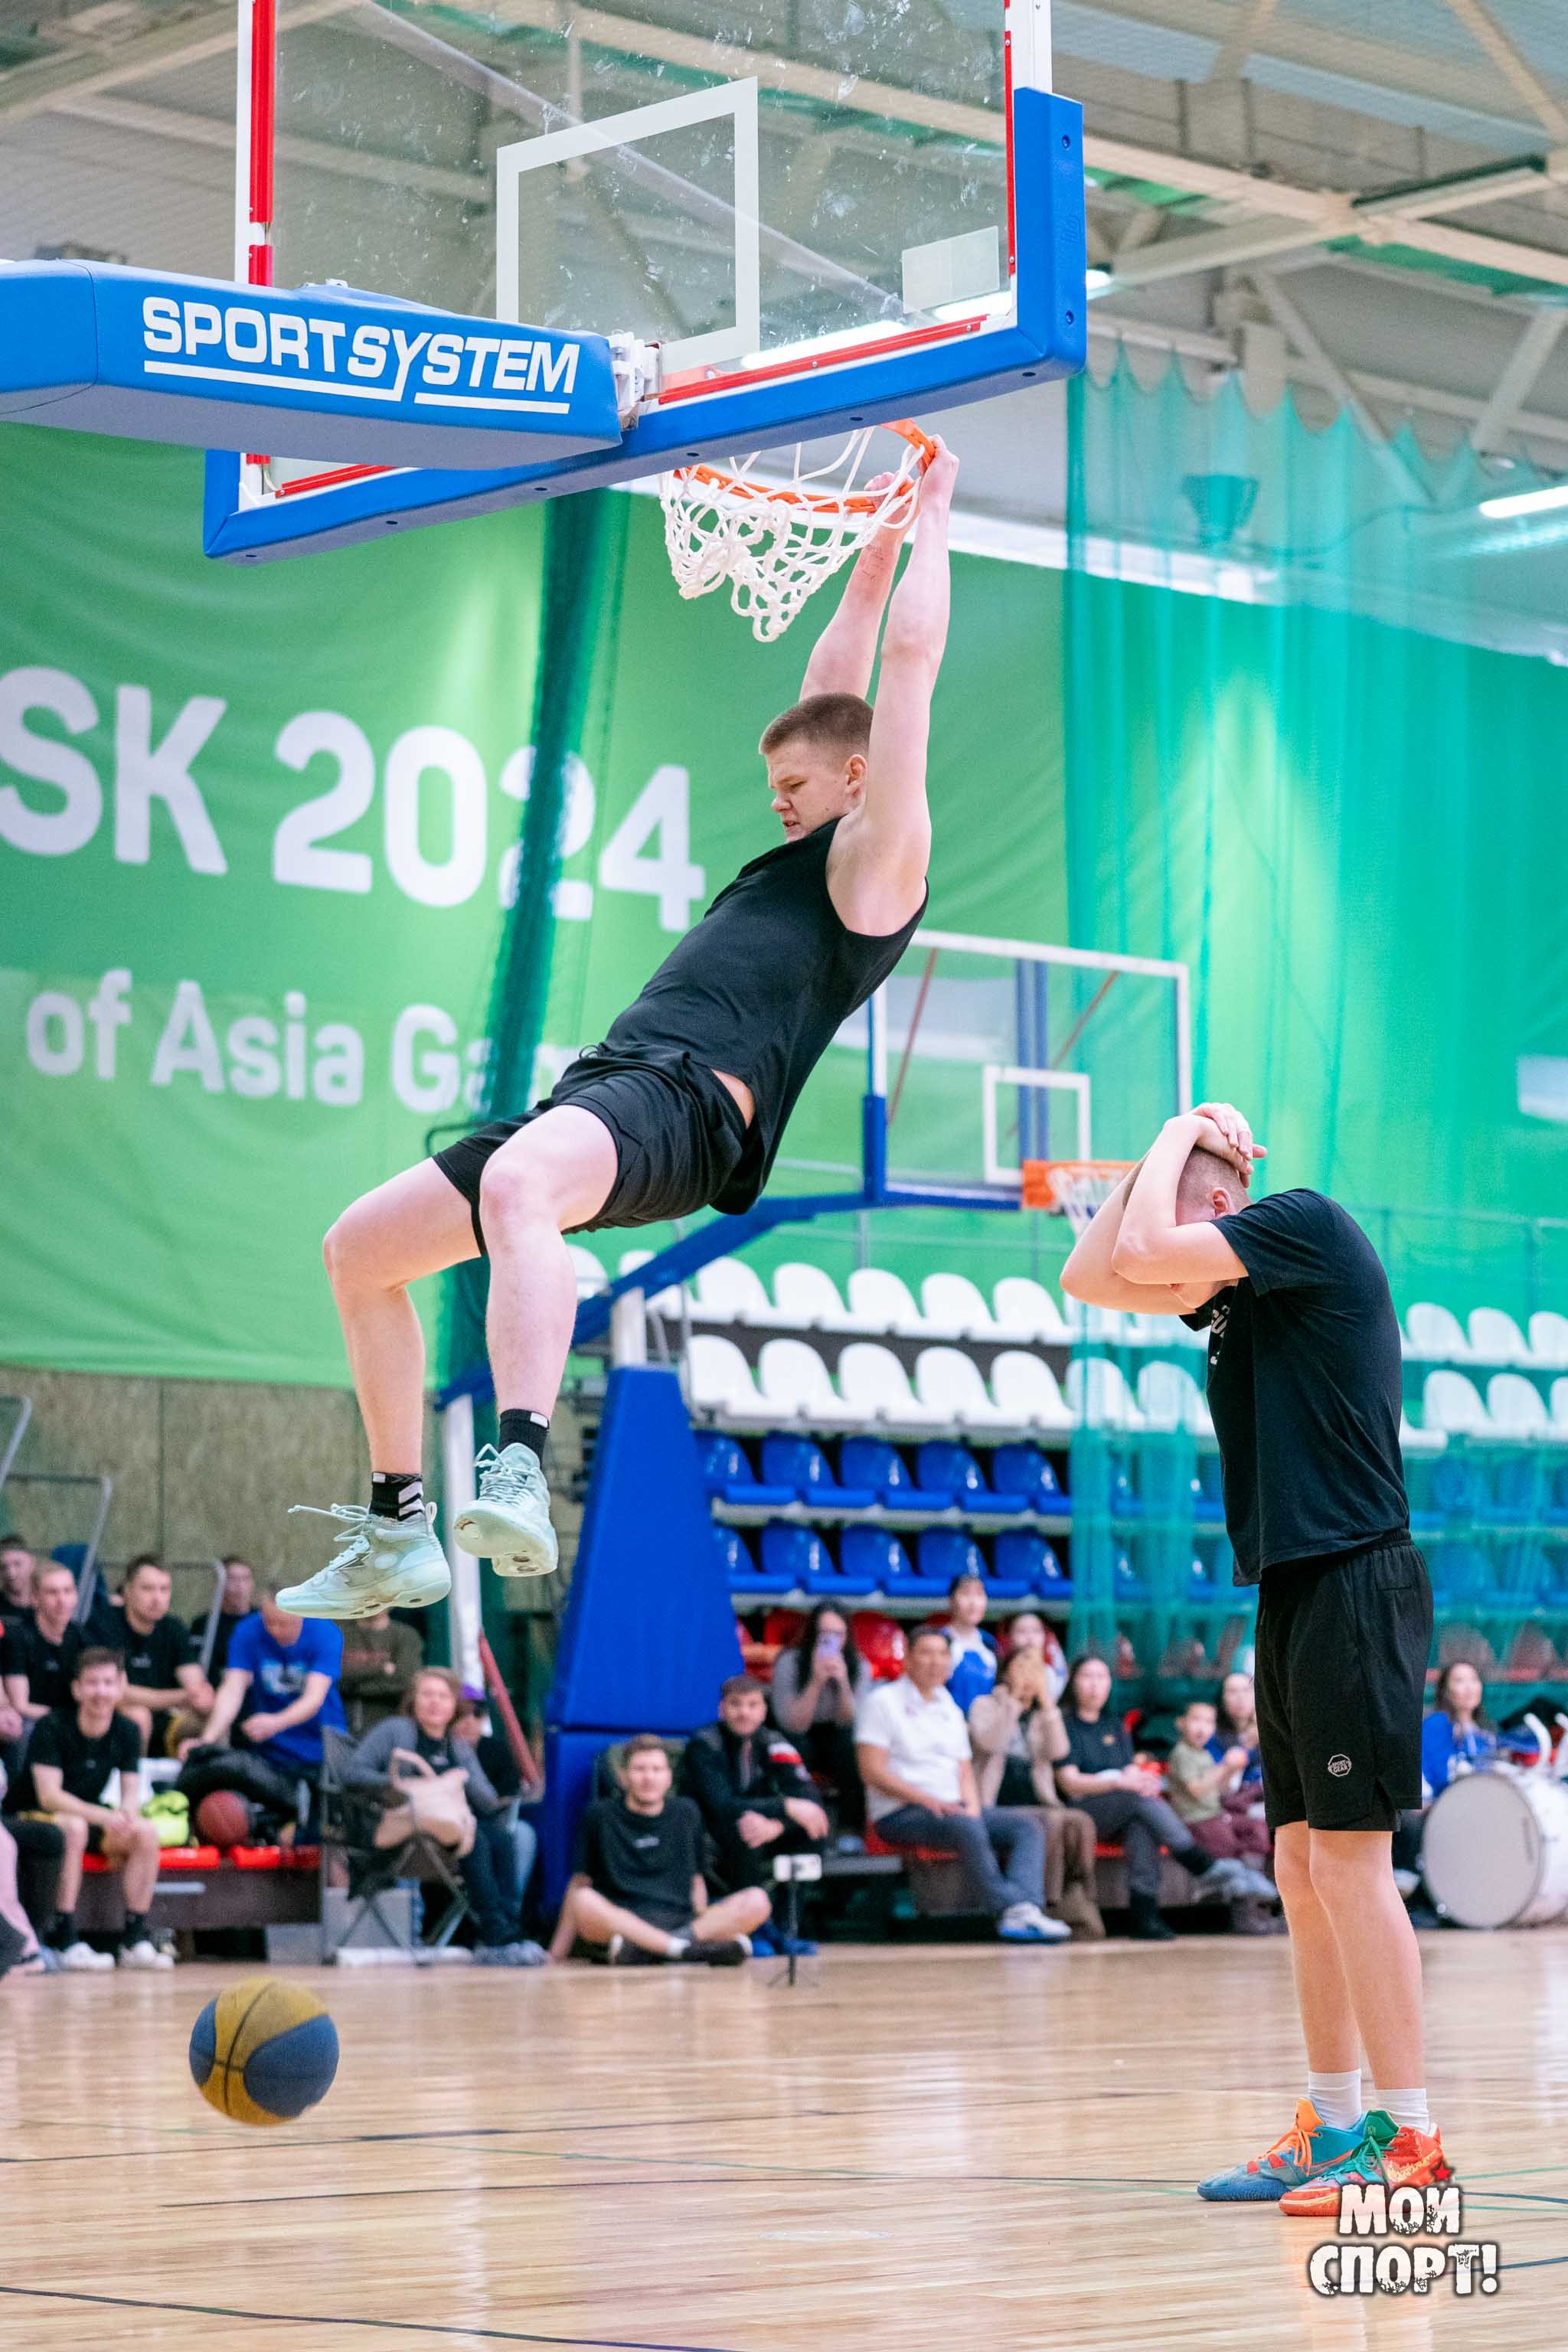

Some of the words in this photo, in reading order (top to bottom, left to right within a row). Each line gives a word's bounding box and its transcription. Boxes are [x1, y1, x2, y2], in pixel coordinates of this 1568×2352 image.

[273, 710, 706, 933] 2024
[26, 968, 132, 1079] of
[149, 979, 364, 1107] Asia
